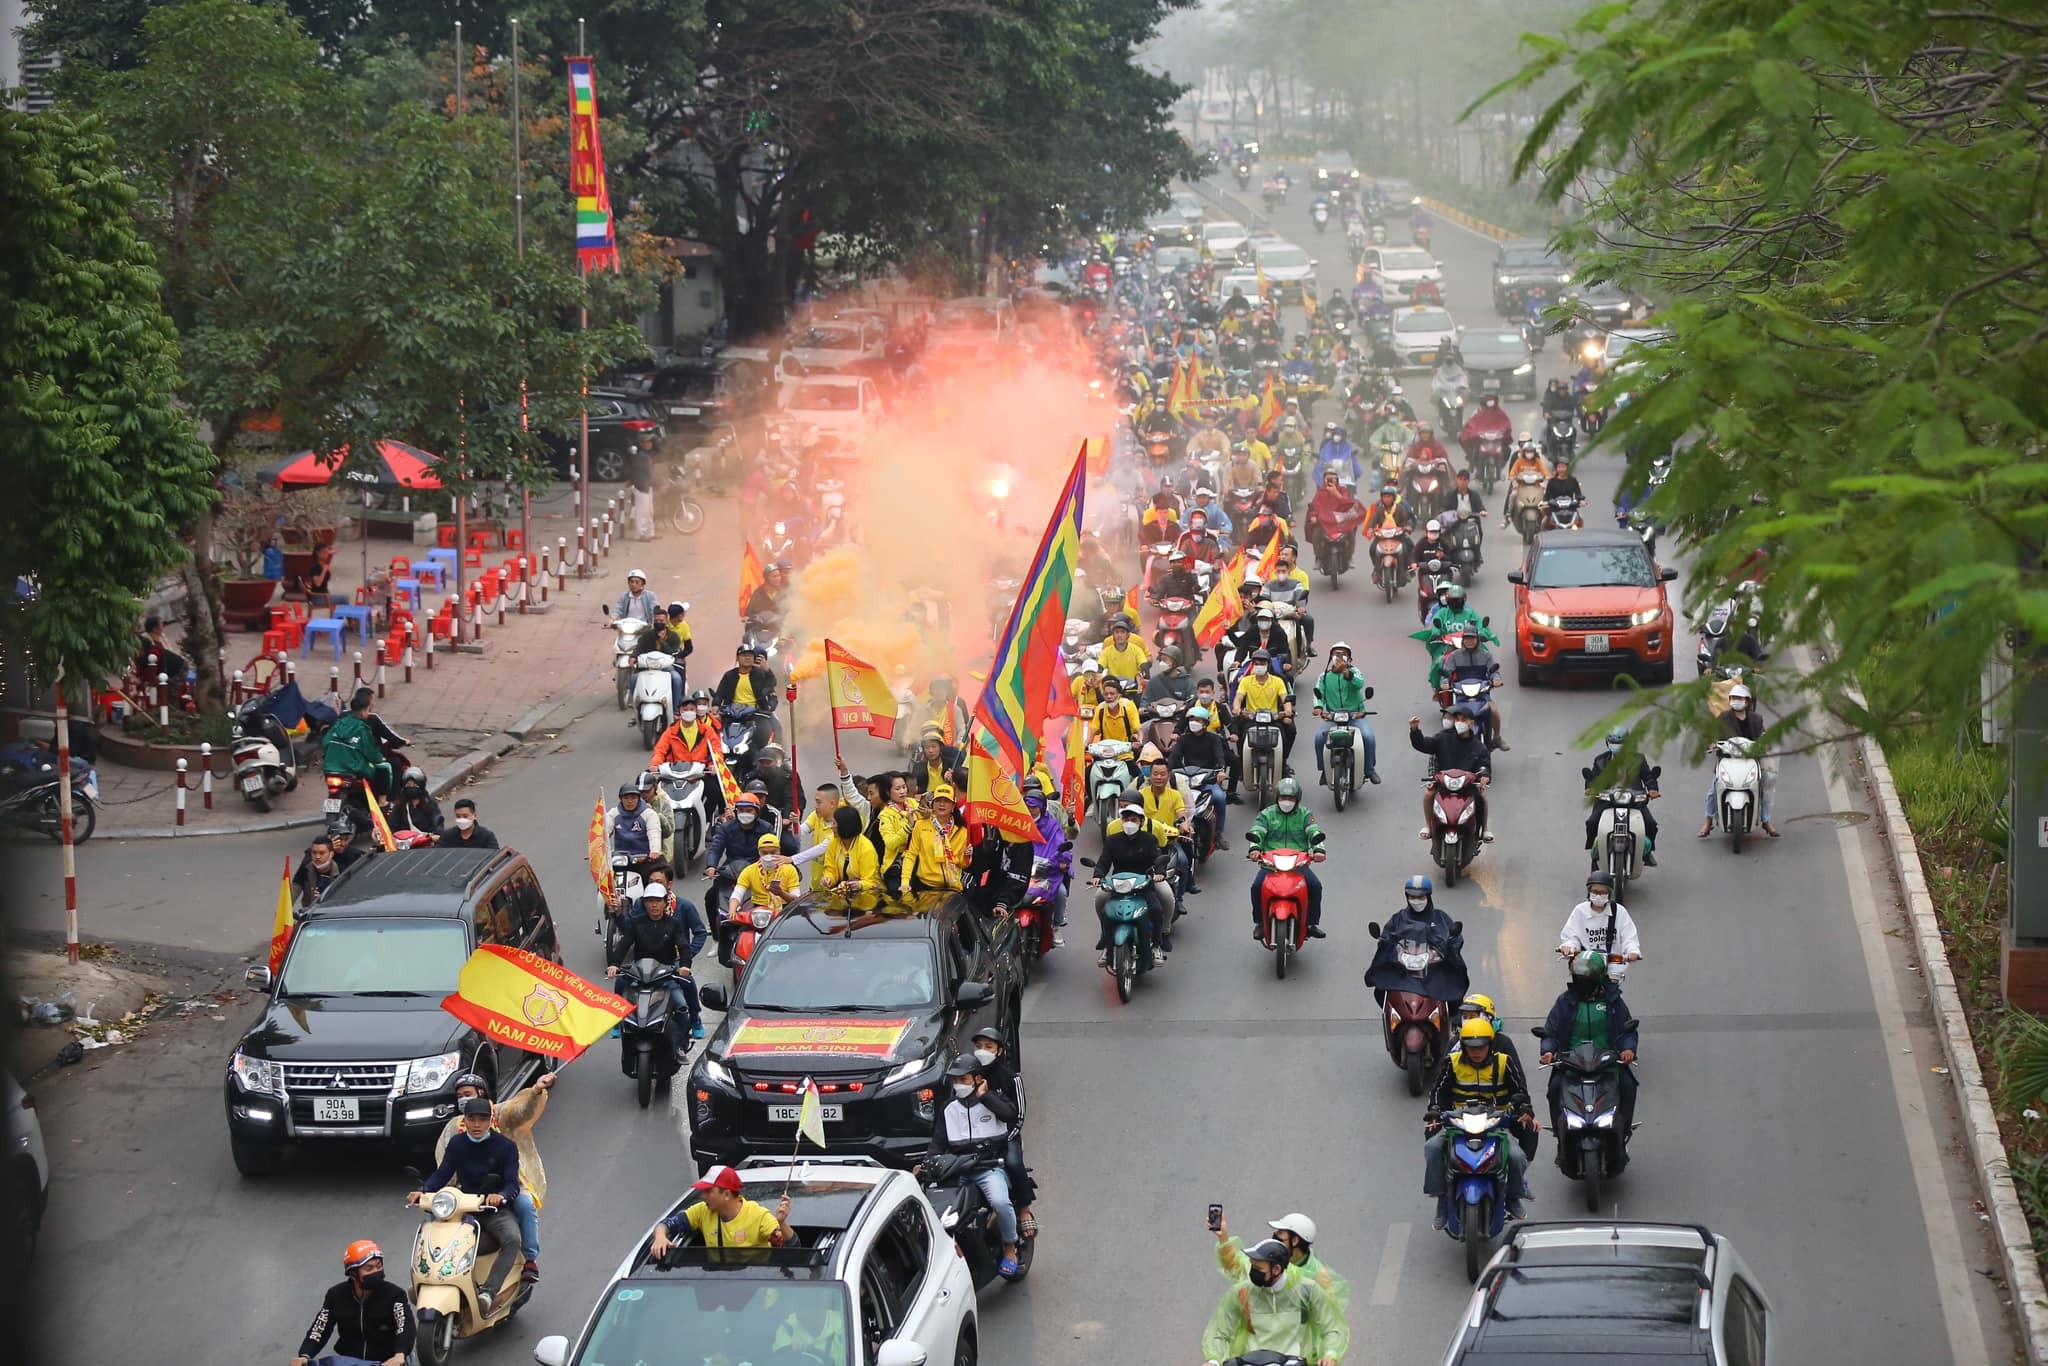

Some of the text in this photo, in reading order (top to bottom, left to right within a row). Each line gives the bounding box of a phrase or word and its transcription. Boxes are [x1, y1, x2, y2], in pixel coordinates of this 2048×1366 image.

[487, 1018, 564, 1052] NAM ĐỊNH
[326, 1099, 346, 1110] 90A
[320, 1110, 354, 1120] 143.98
